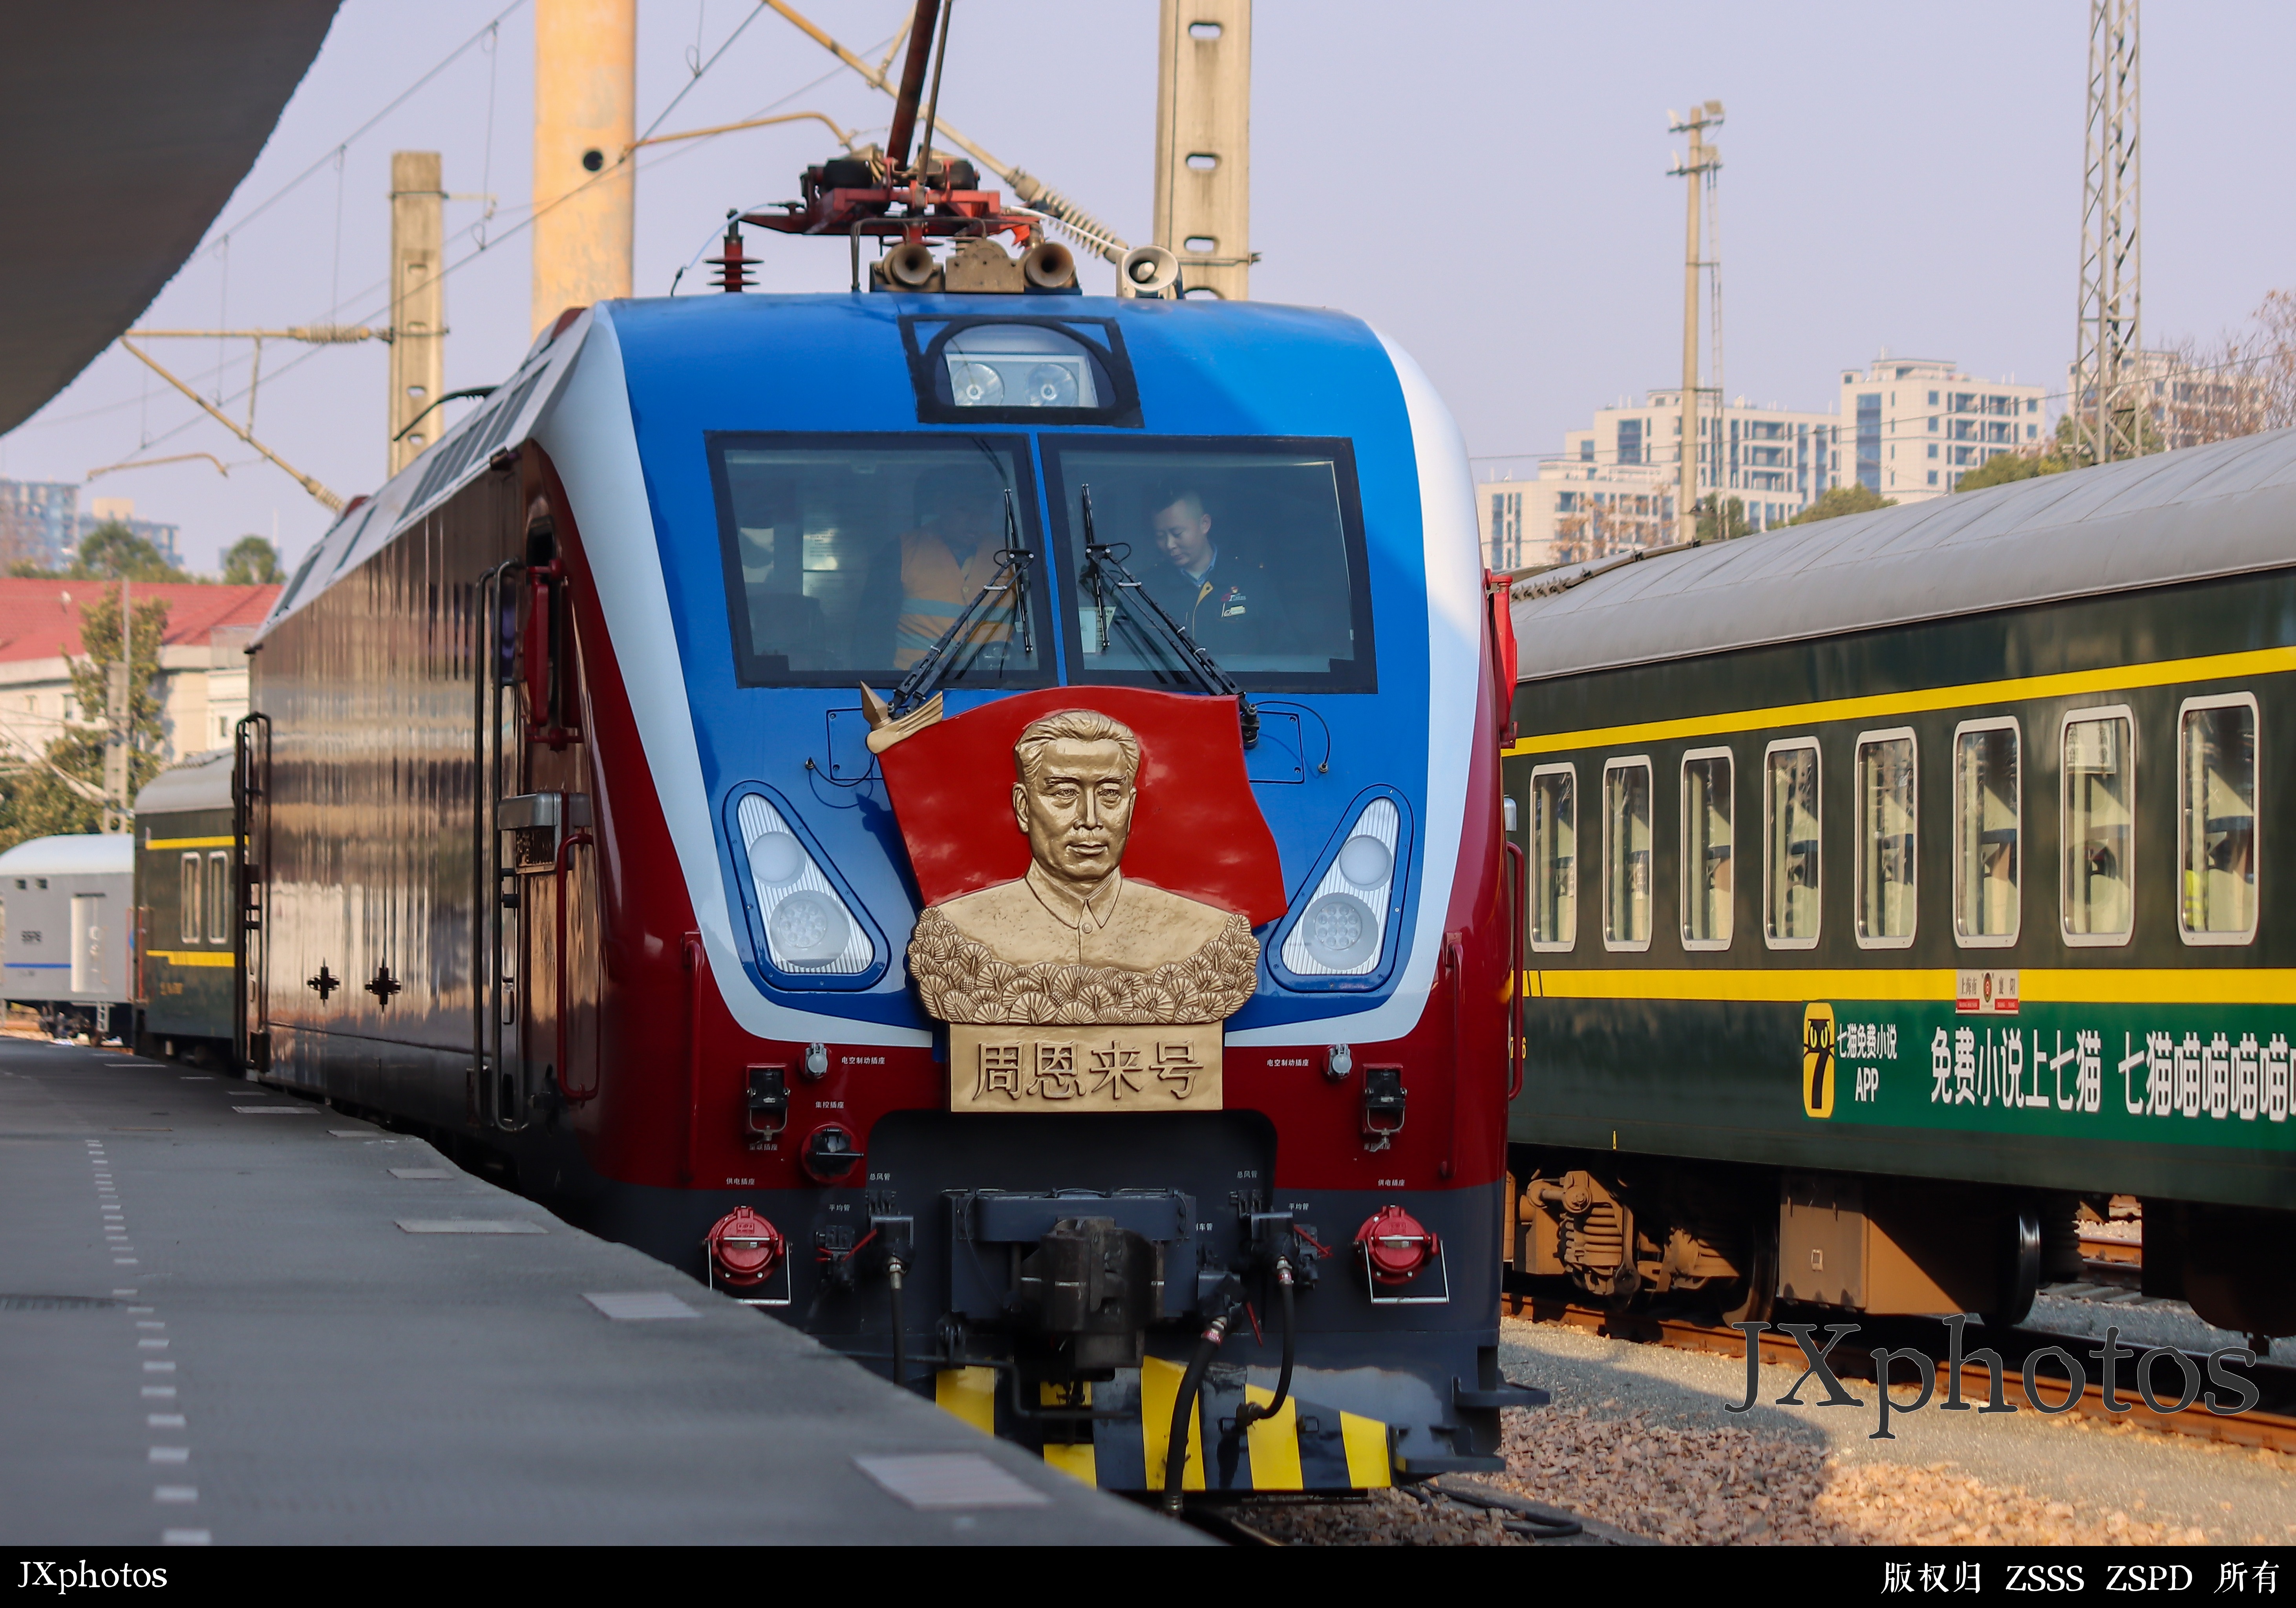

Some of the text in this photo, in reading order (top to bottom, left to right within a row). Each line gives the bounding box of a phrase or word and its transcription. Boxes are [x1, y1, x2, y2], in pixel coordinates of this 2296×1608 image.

[1837, 1023, 1897, 1059] 七猫免费小说
[841, 1056, 885, 1065] 电空制动插座
[973, 1040, 1204, 1100] 周恩来号
[1931, 1026, 2101, 1112] 免费小说上七猫
[1855, 1067, 1879, 1102] APP
[869, 1173, 890, 1181] 总风管
